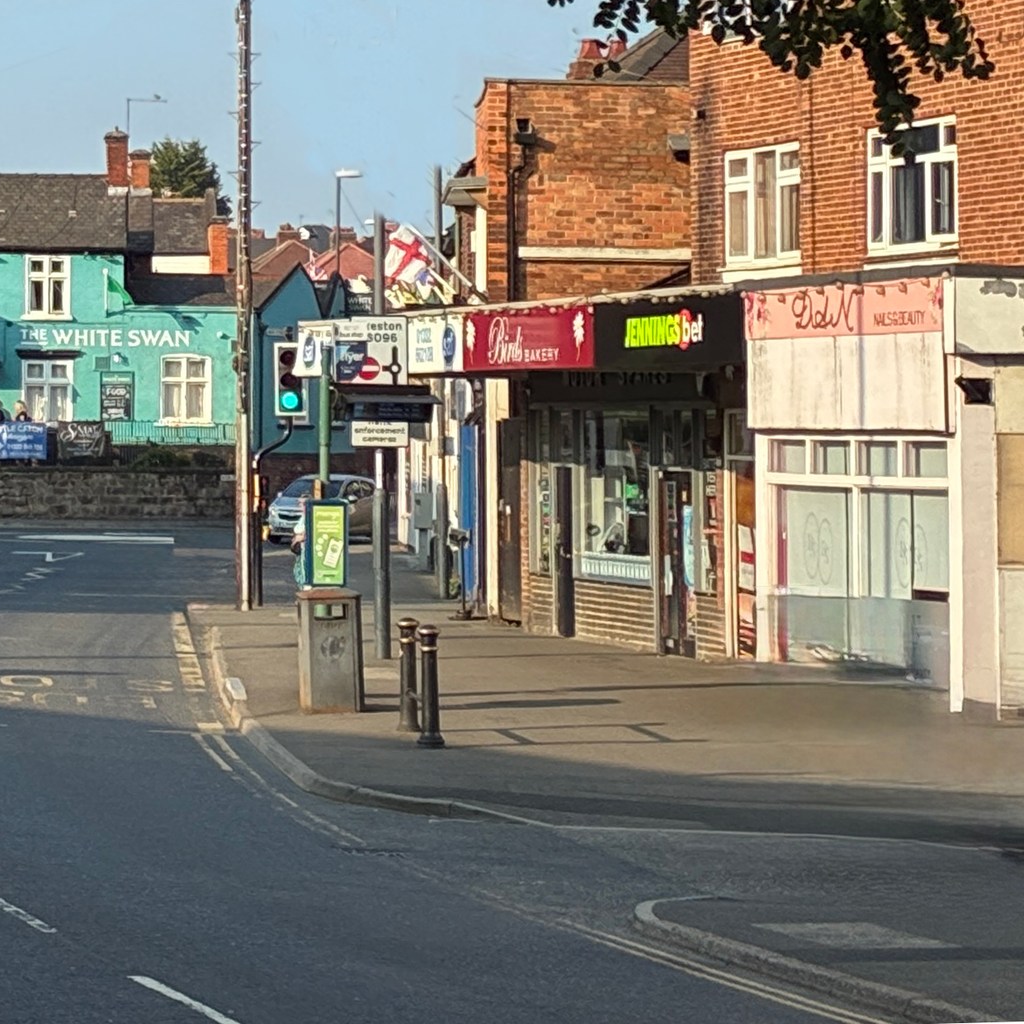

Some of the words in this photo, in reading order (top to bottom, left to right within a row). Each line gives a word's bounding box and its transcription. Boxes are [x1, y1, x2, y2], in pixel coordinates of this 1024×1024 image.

[367, 321, 402, 331] eston
[20, 329, 47, 340] THE
[52, 329, 123, 347] WHITE
[128, 329, 190, 347] SWAN
[524, 347, 559, 363] BAKERY
[354, 426, 405, 435] enforcement
